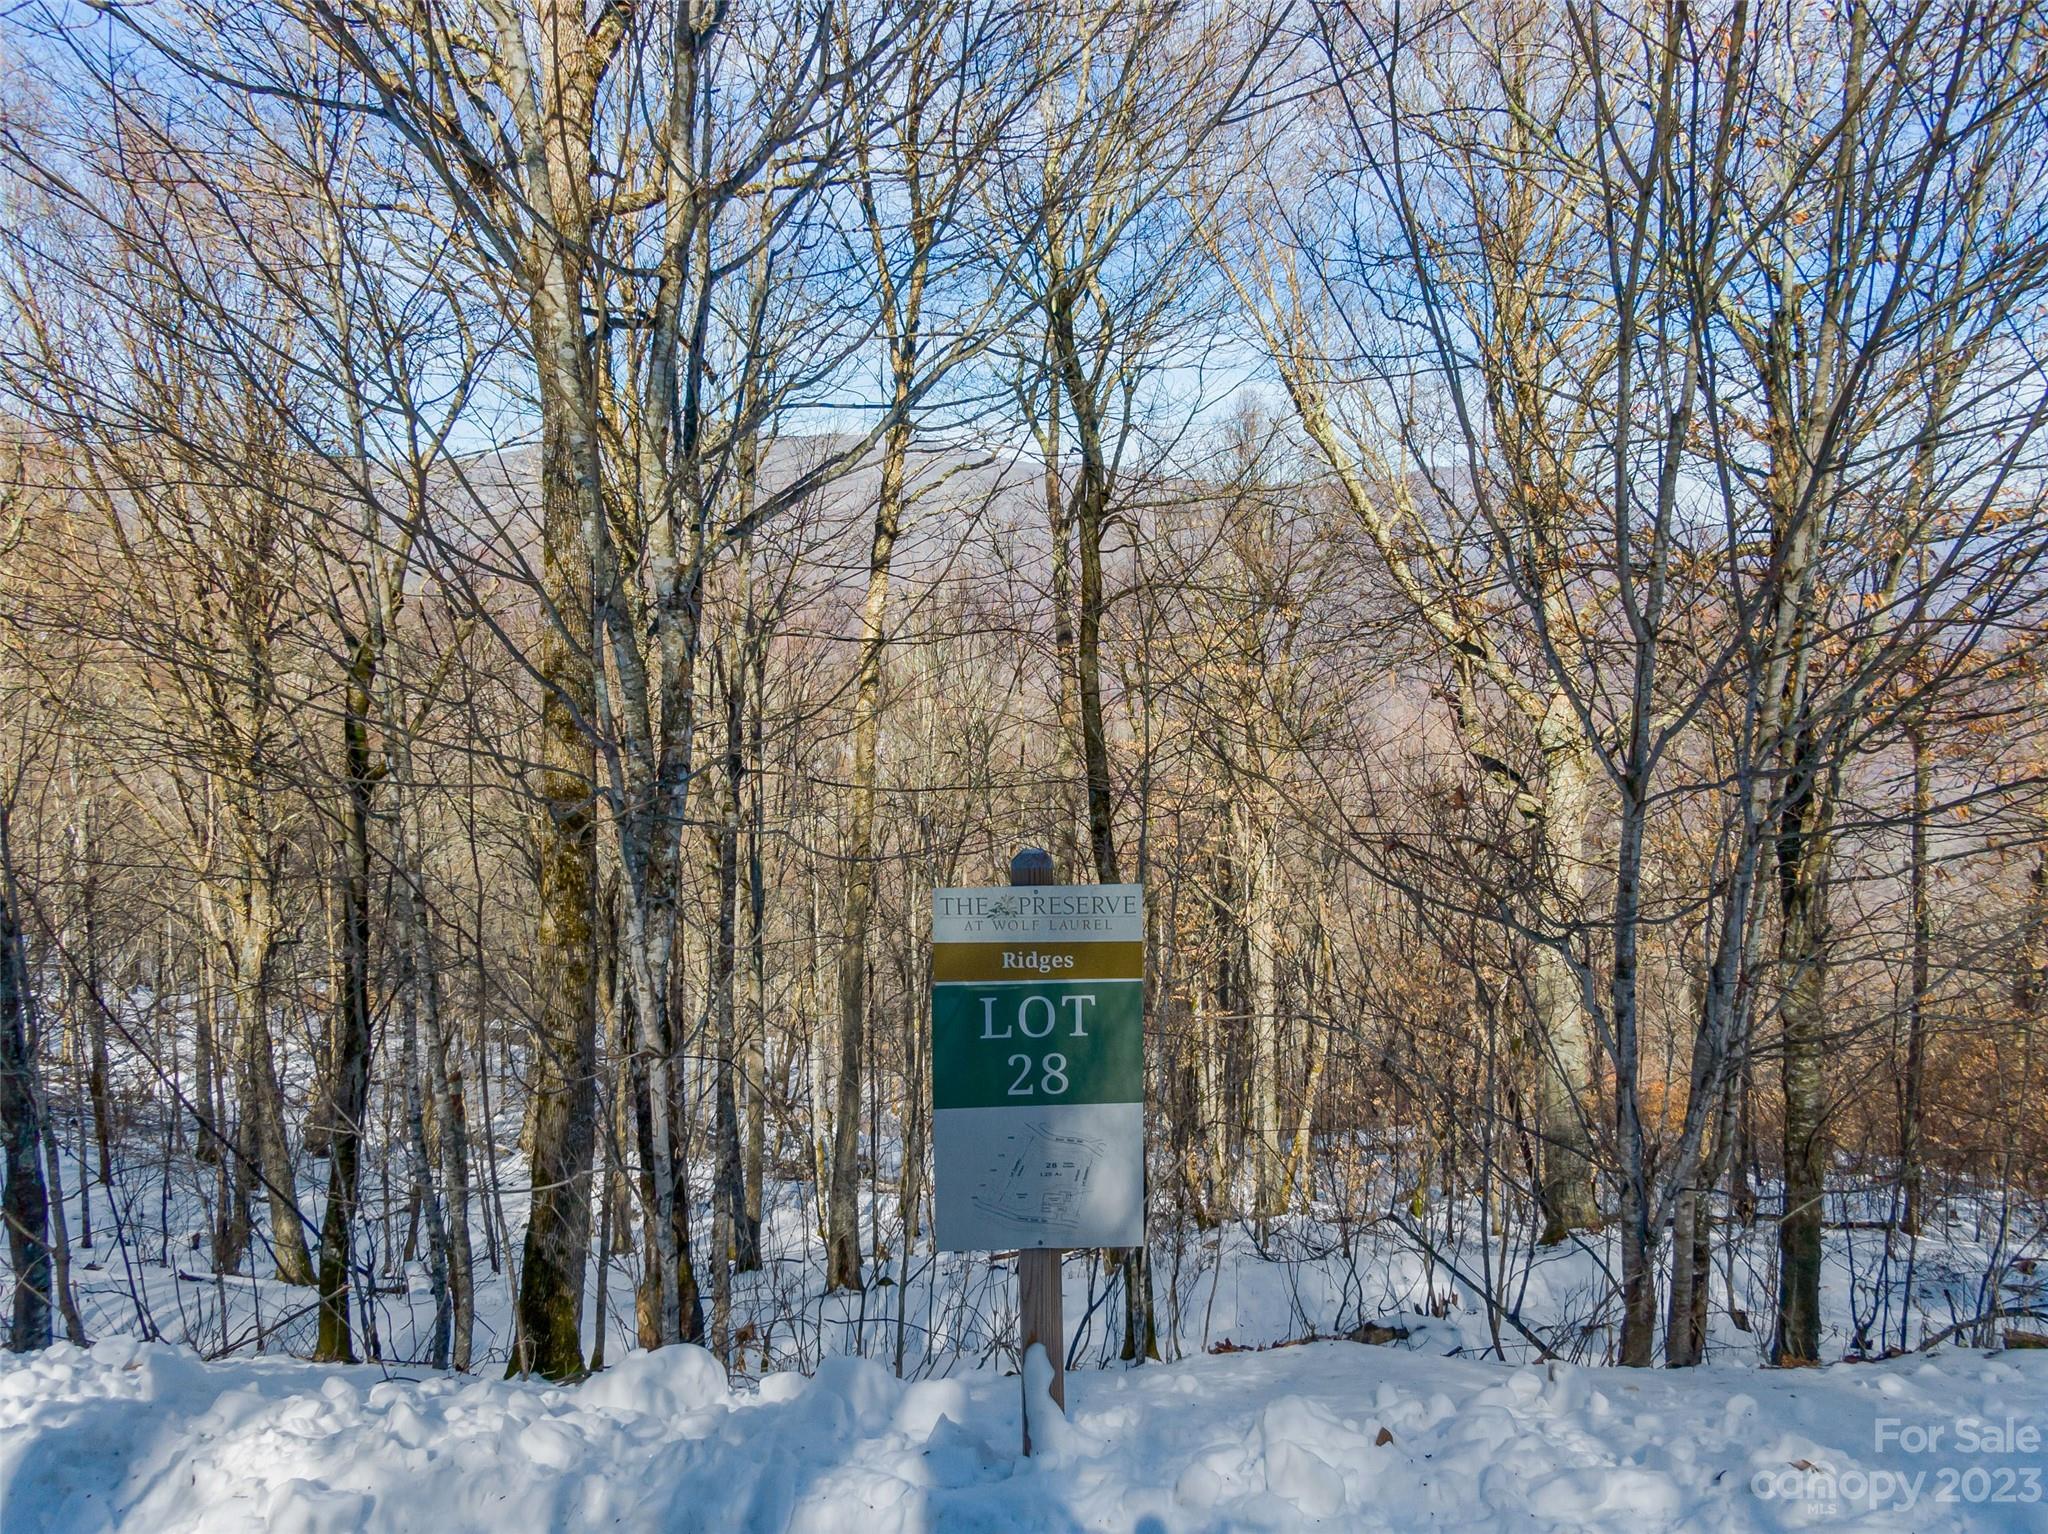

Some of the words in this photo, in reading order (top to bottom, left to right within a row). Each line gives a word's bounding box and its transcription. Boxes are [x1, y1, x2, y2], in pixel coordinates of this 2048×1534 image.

[940, 897, 988, 916] THE
[1018, 895, 1137, 915] PRESERVE
[964, 921, 983, 931] AT
[993, 920, 1040, 931] WOLF
[1049, 919, 1113, 931] LAUREL
[1002, 952, 1074, 973] Ridges
[979, 995, 1096, 1039] LOT
[1007, 1053, 1069, 1095] 28
